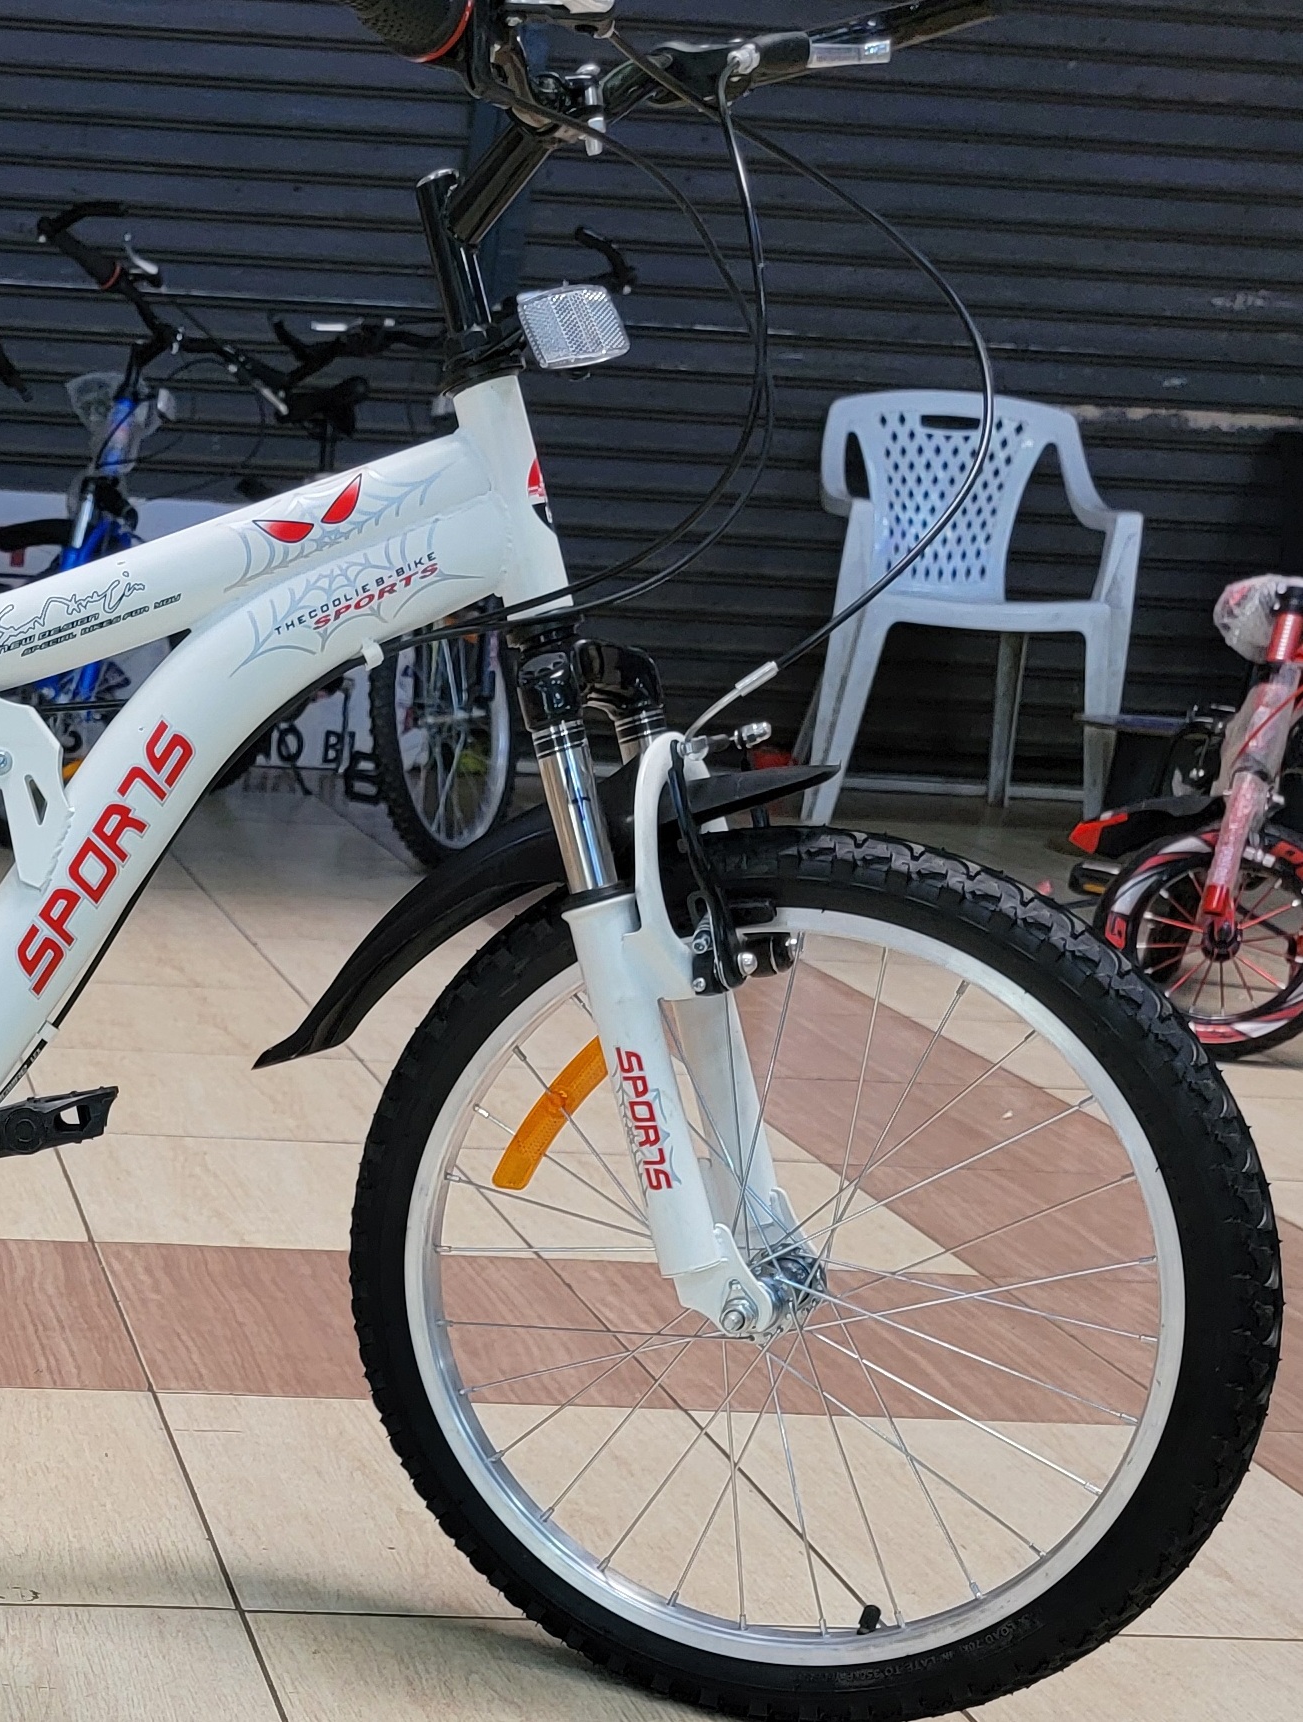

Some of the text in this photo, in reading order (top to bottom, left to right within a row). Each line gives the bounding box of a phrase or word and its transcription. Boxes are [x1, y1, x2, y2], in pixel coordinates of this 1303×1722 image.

[21, 632, 77, 657] SPECIAL
[122, 605, 150, 621] FOR
[153, 593, 182, 610] YOU
[37, 612, 100, 642] DESIGN
[312, 562, 439, 631] SPORTS
[16, 719, 196, 997] SPORTS
[614, 1046, 674, 1191] SPORTS
